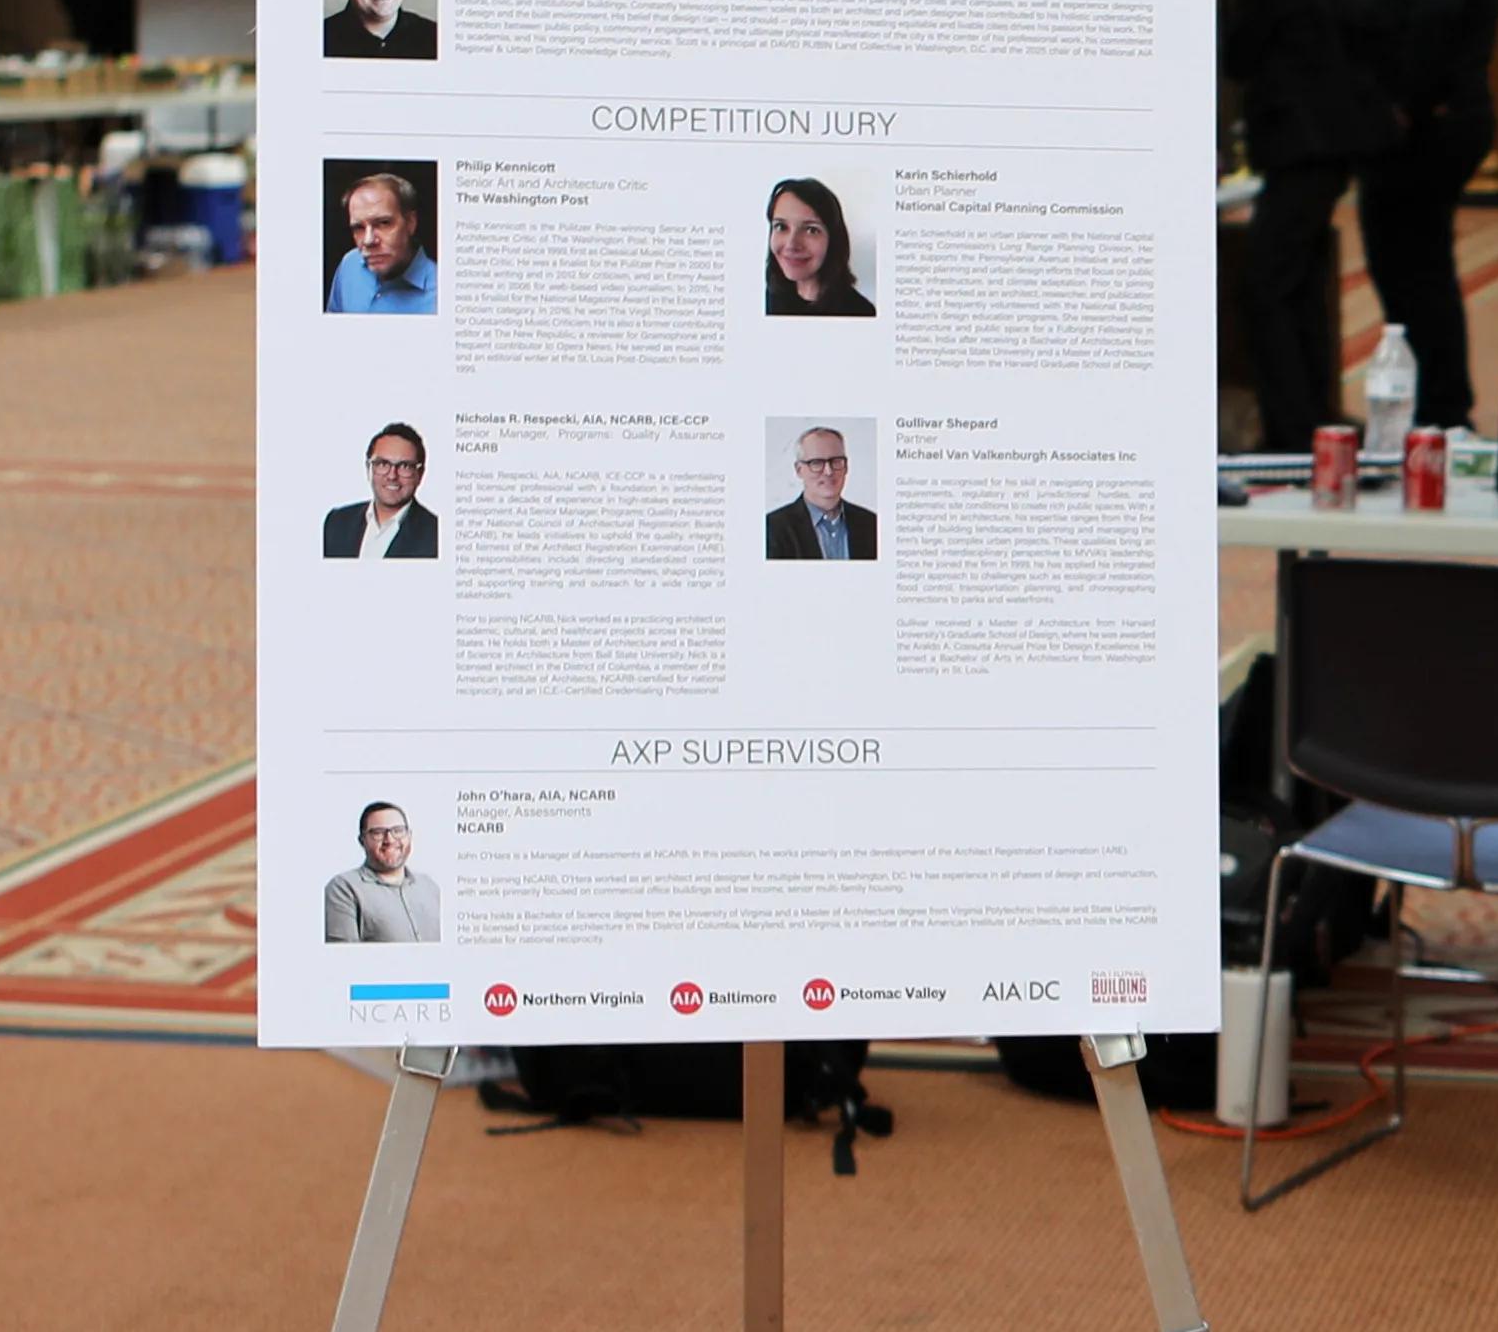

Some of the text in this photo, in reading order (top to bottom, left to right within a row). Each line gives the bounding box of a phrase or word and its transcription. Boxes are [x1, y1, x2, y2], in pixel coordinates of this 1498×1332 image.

[591, 106, 897, 137] COMPETITION JURY
[455, 159, 556, 175] Philip Kennicott
[895, 168, 998, 182] Karin Schierhold
[455, 191, 589, 207] The Washington Post
[895, 199, 1124, 216] National Capital Planning Commission
[455, 412, 506, 424] Nicholas
[609, 414, 656, 426] NCARB,
[658, 414, 709, 426] ICE-CCP
[895, 416, 998, 431] Gullivar Shepard
[895, 448, 1137, 463] Michael Van Valkenburgh Associates Inc
[610, 739, 882, 765] AXP SUPERVISOR
[456, 790, 486, 802] John
[568, 789, 616, 801] NCARB
